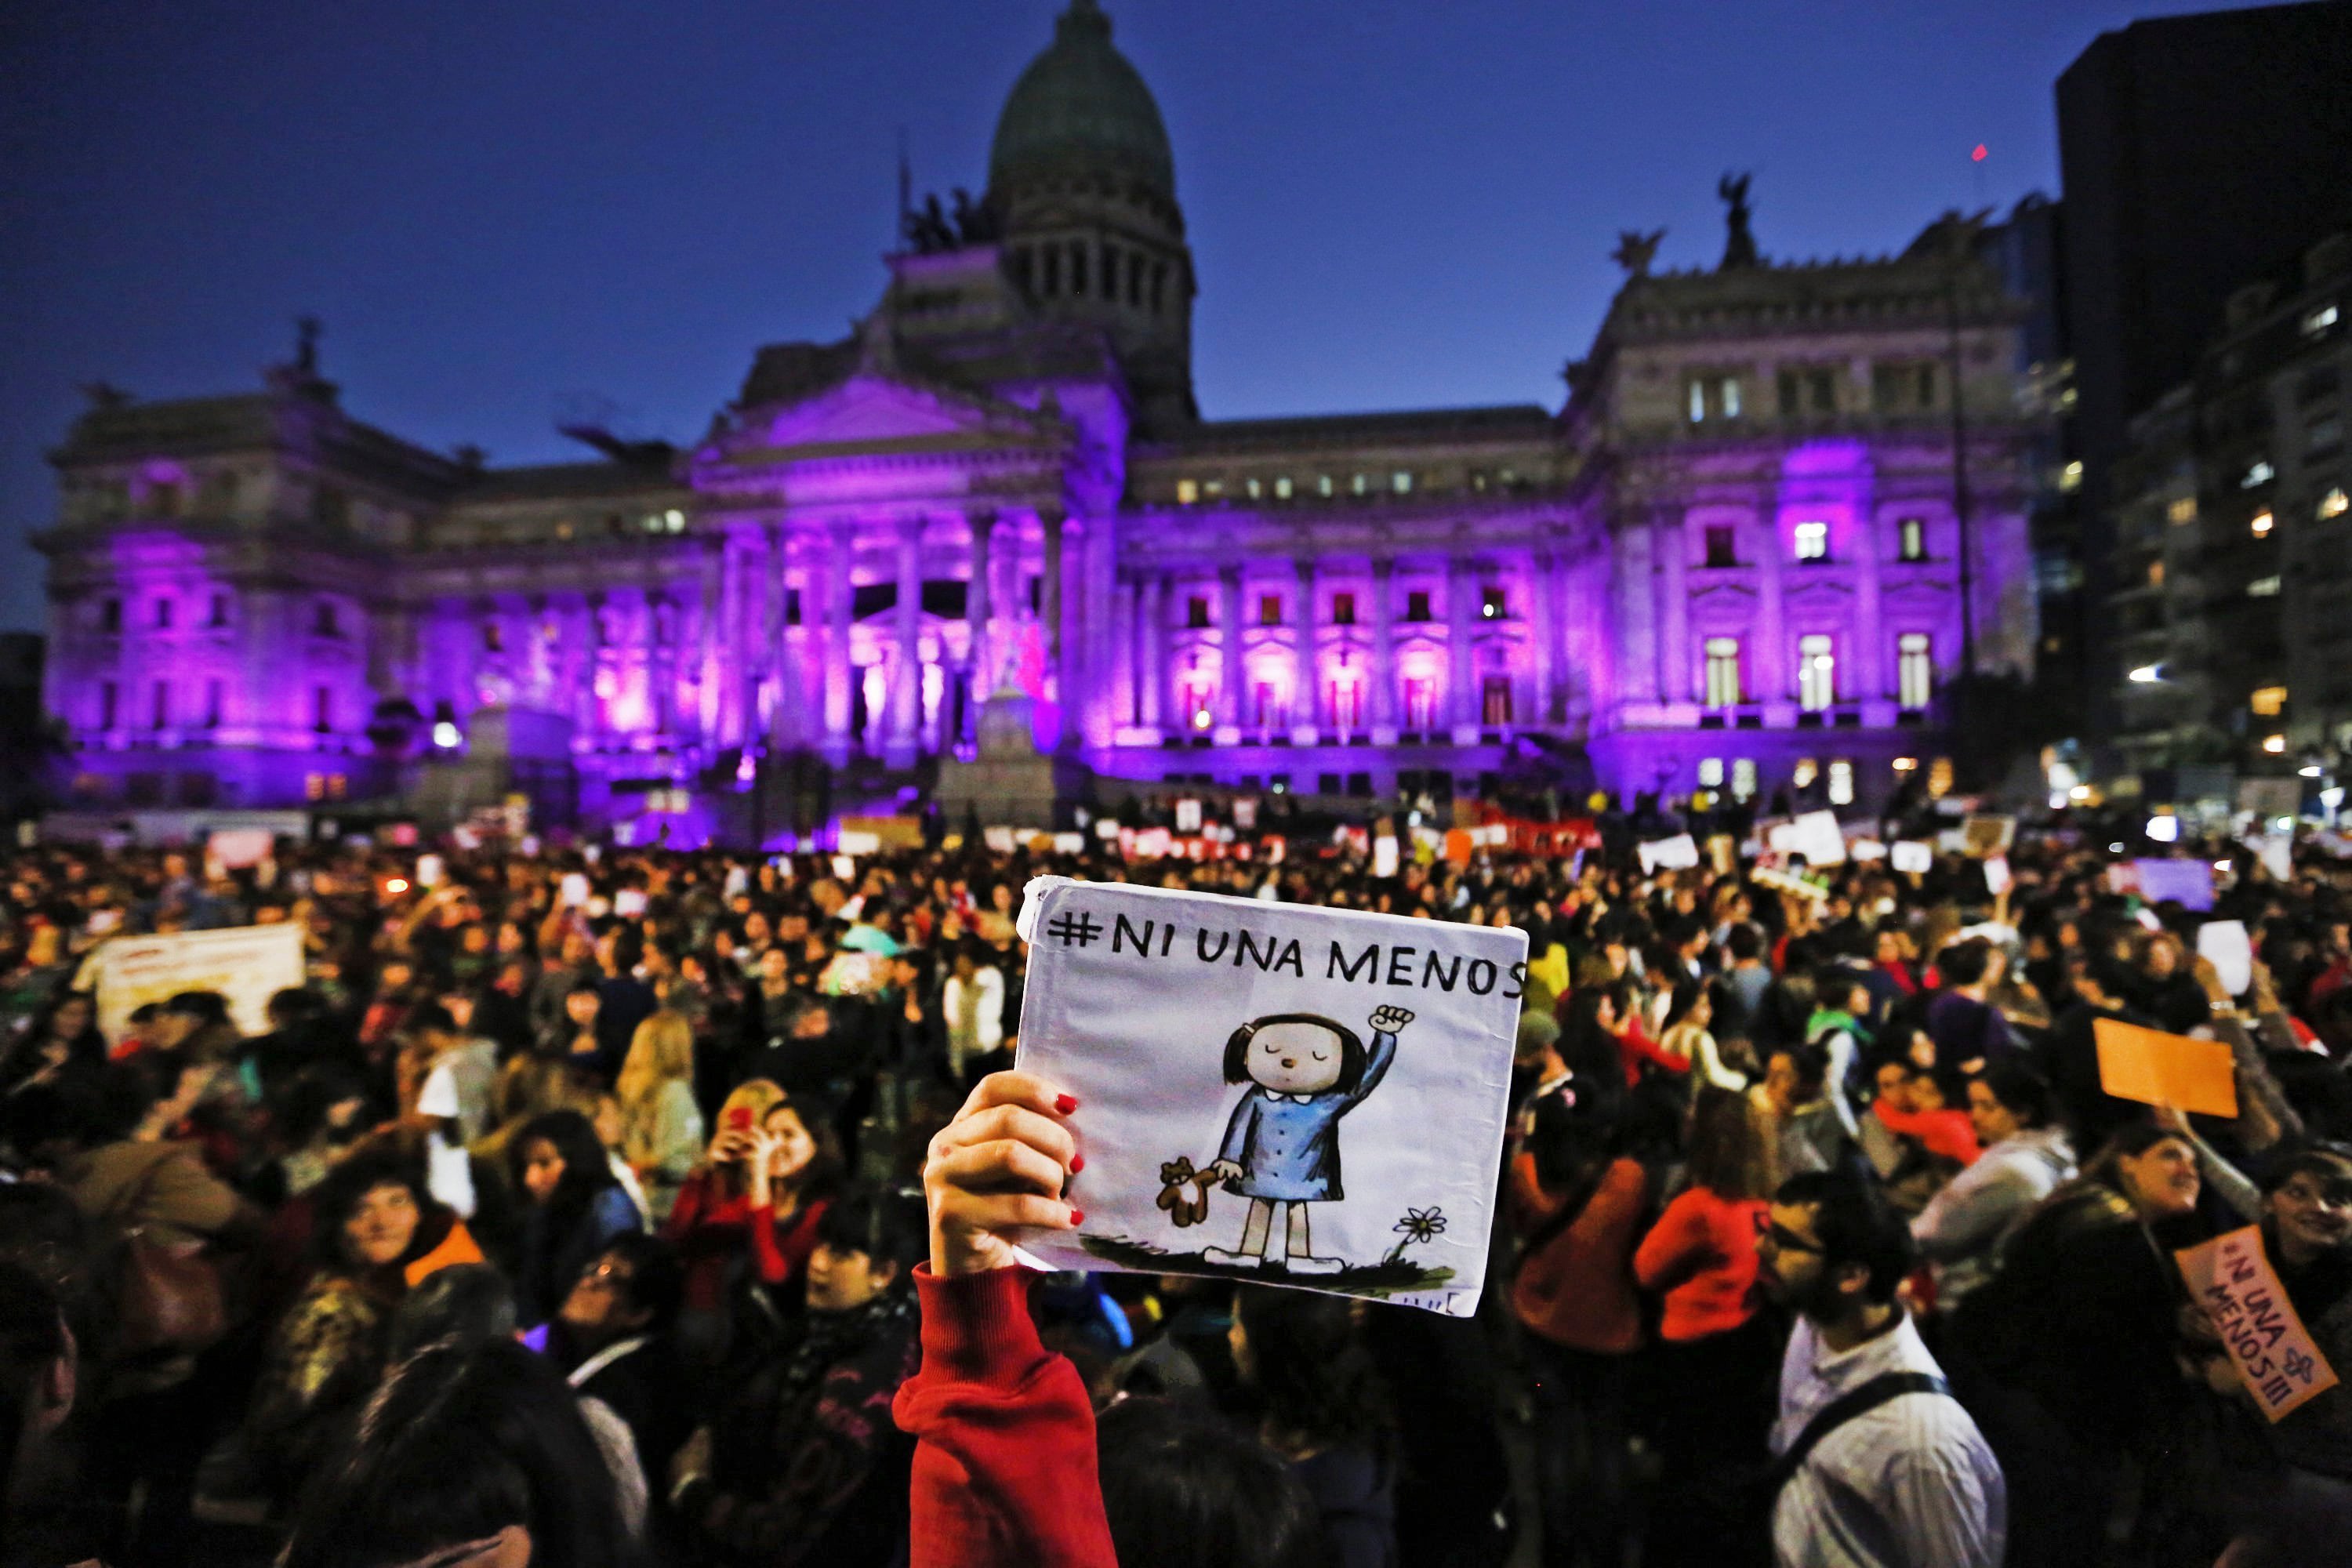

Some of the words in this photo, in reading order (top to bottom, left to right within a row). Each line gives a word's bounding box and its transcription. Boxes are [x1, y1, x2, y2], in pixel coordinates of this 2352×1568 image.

[1196, 927, 1305, 978] UNA
[1326, 940, 1526, 1000] MENOS
[2244, 1287, 2287, 1349] UNA
